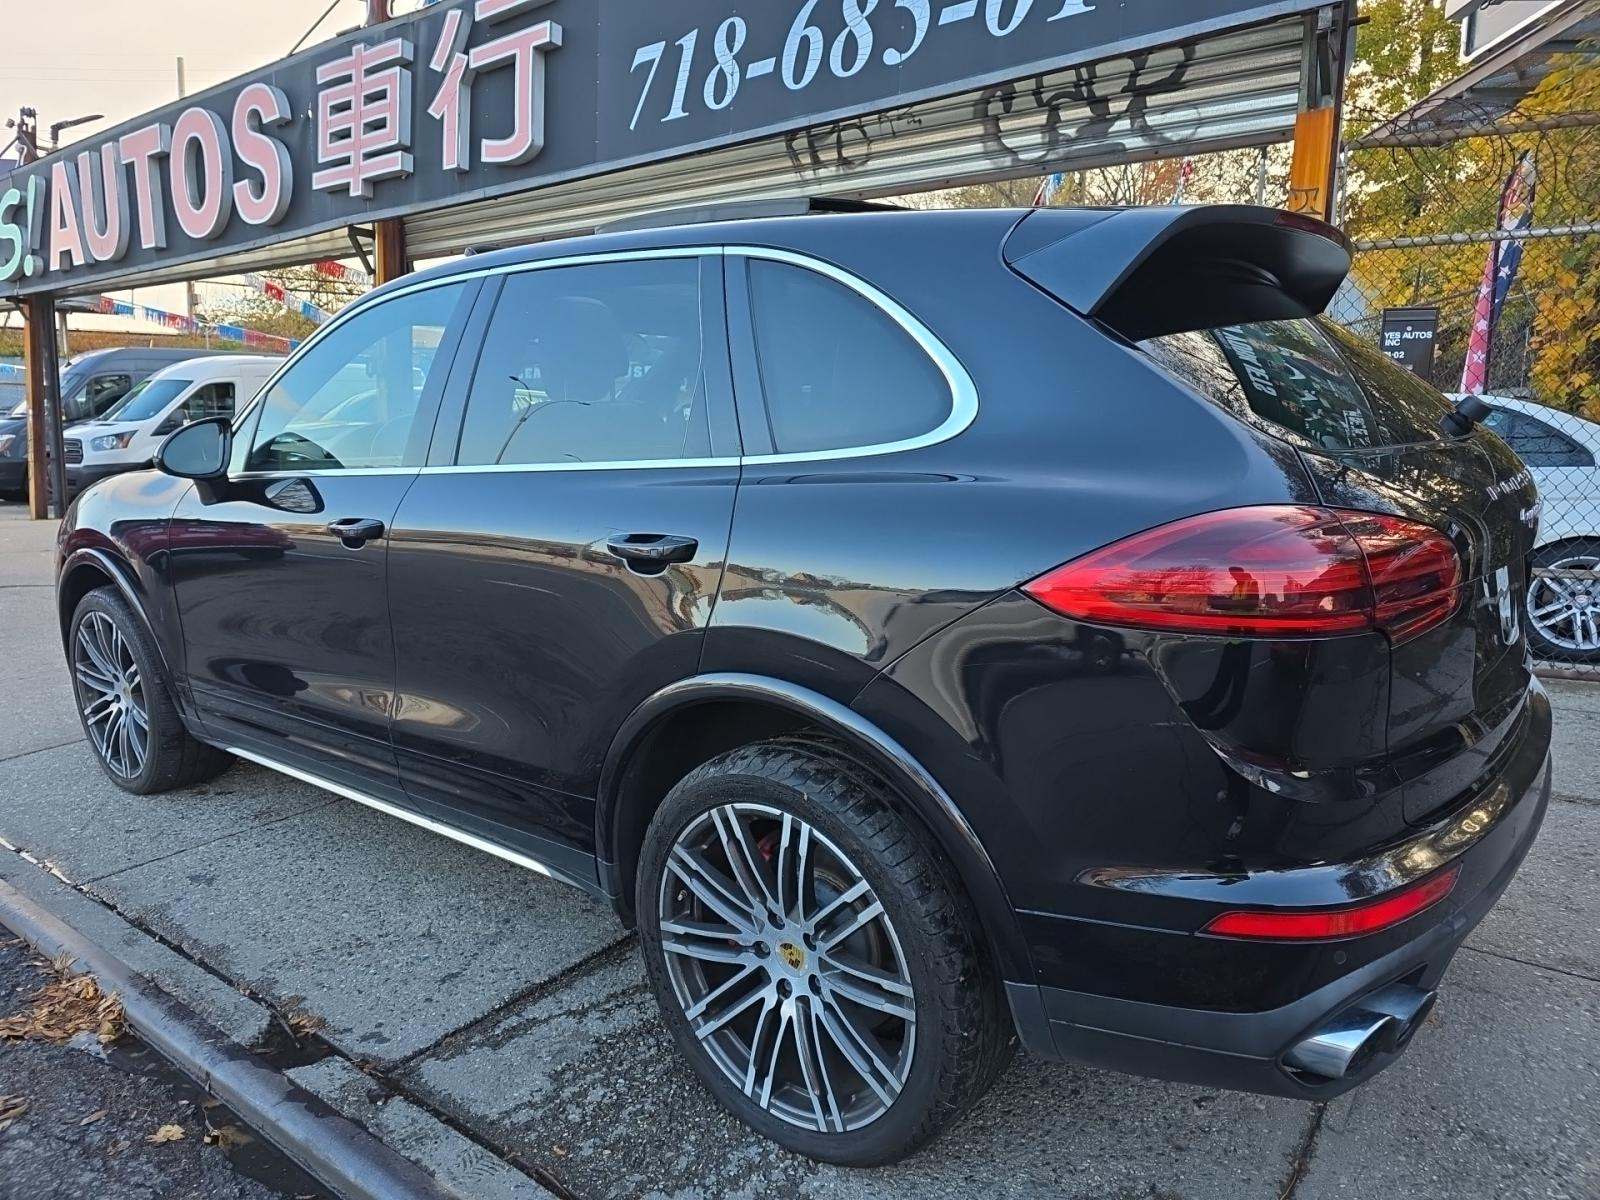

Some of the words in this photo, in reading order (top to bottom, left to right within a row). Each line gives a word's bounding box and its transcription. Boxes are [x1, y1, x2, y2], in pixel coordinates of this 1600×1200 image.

[50, 82, 291, 271] AUTOS
[312, 0, 562, 198] 車行
[1384, 331, 1401, 339] YES
[1402, 331, 1433, 339] AUTOS
